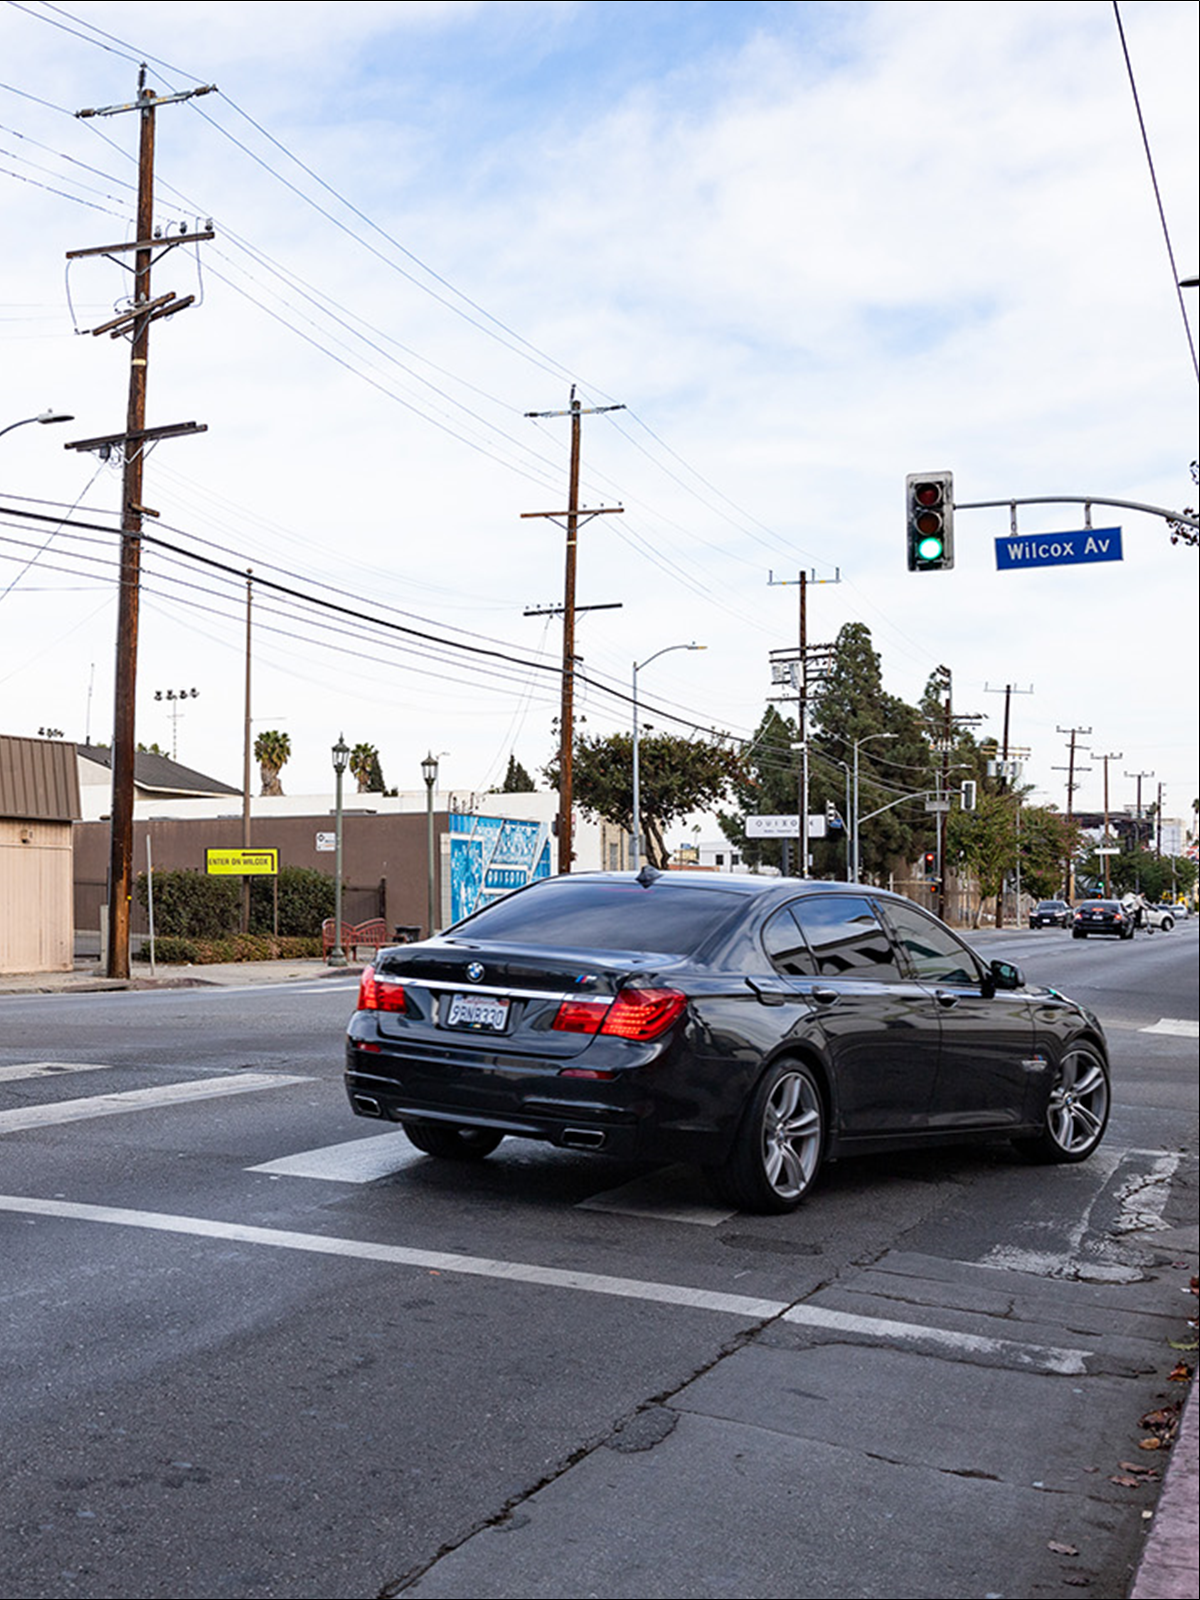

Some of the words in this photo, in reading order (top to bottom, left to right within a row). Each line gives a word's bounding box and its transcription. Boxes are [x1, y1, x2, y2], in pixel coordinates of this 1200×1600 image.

[1007, 542, 1074, 560] Wilcox
[1084, 537, 1110, 554] Av
[208, 857, 230, 866] ENTER
[232, 857, 242, 866] ON
[243, 857, 269, 866] WILCOX
